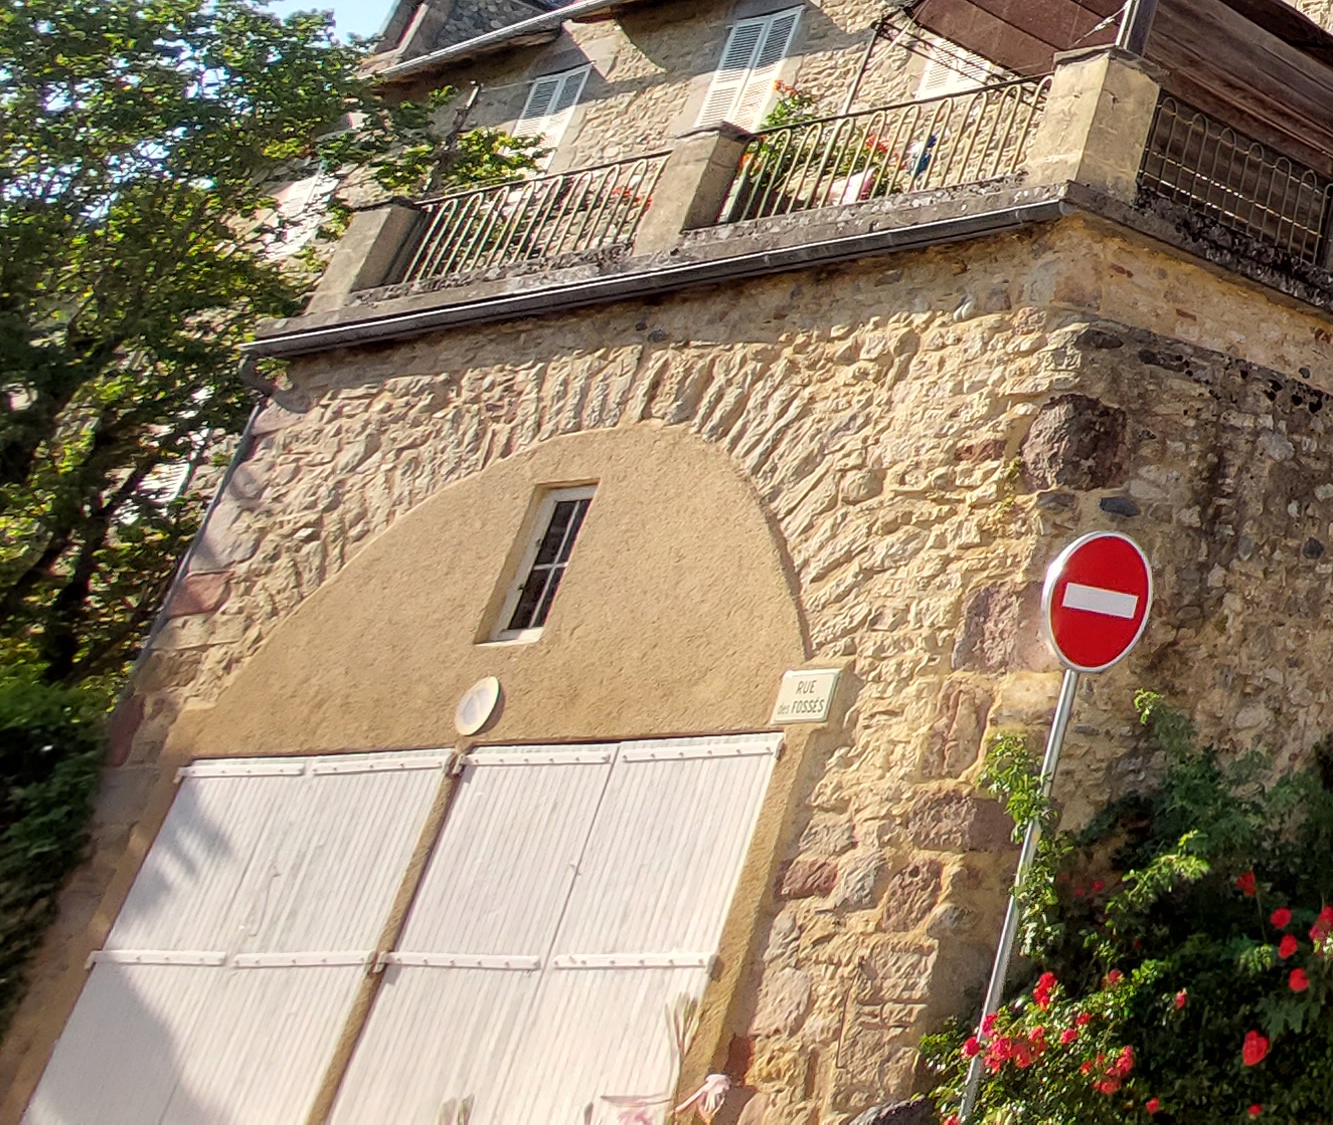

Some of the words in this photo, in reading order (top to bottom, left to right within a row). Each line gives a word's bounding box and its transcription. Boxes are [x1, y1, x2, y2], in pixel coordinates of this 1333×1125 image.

[795, 679, 817, 695] RUE
[777, 702, 790, 715] des
[791, 696, 825, 714] FOSSÉS
